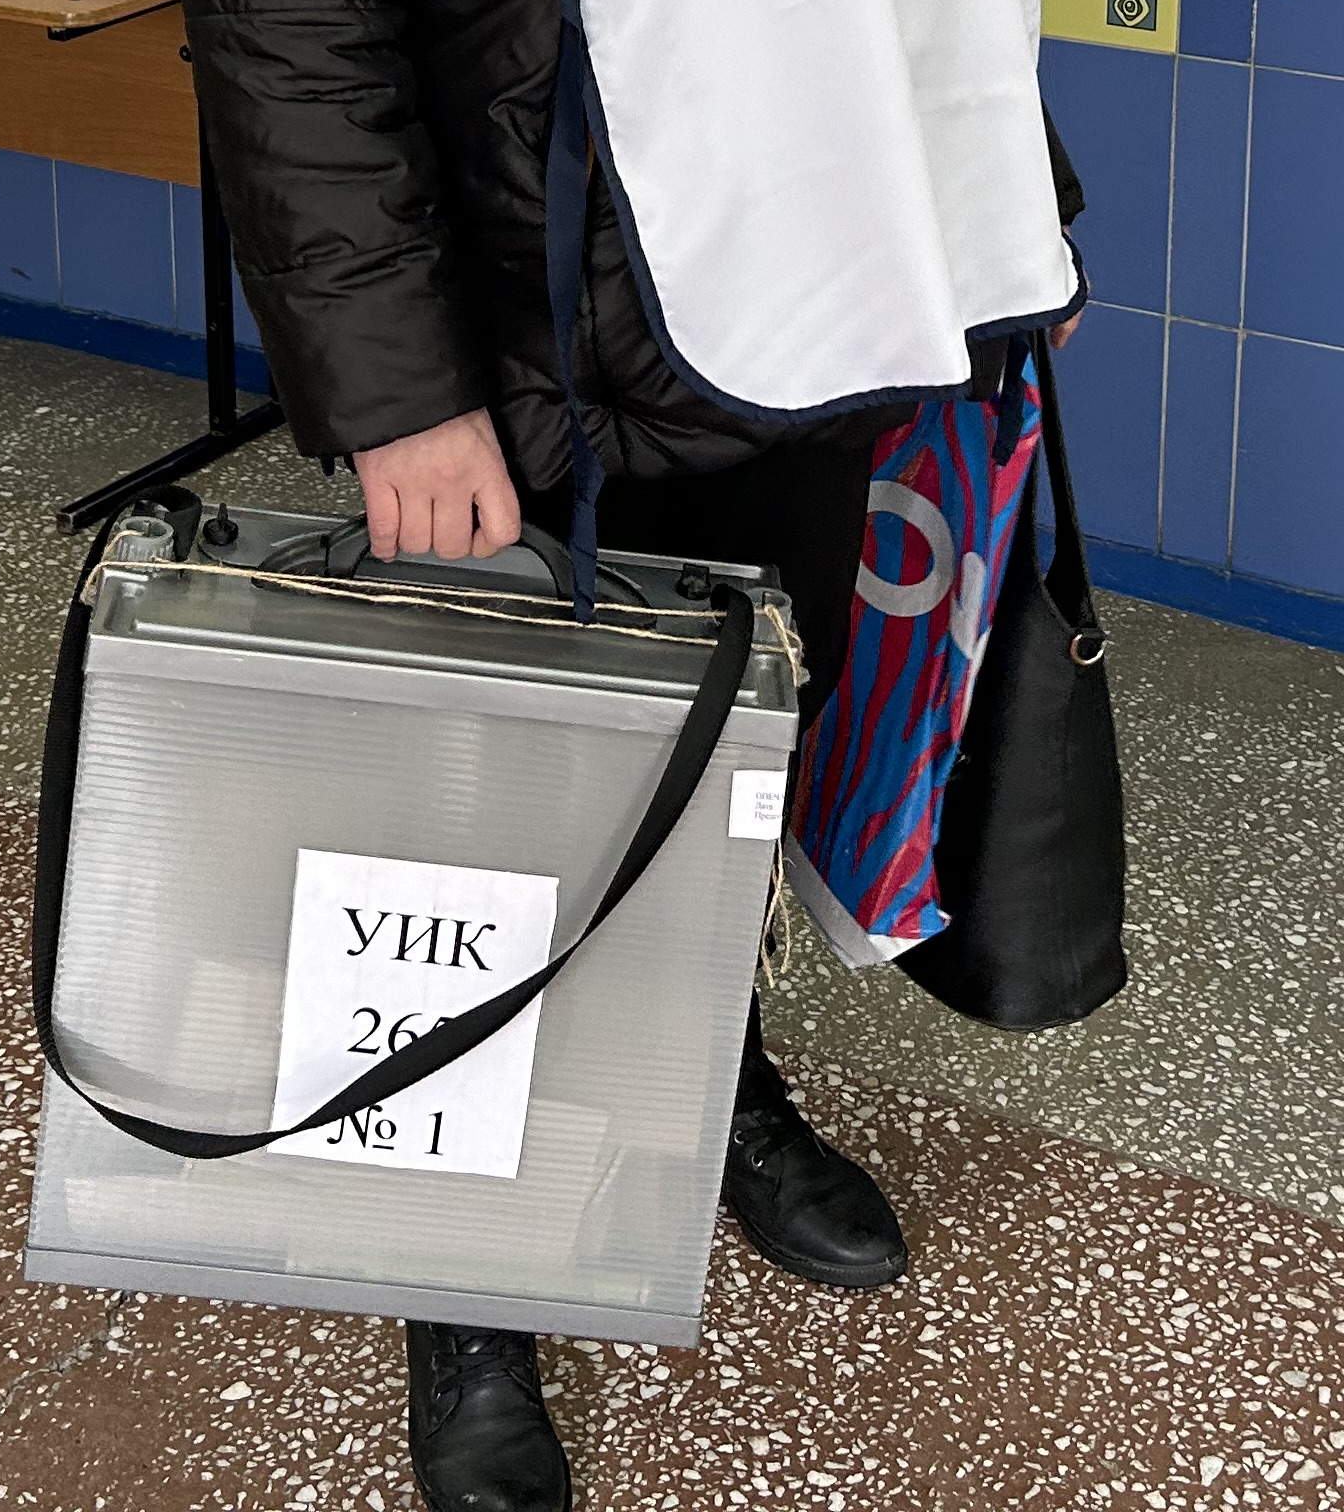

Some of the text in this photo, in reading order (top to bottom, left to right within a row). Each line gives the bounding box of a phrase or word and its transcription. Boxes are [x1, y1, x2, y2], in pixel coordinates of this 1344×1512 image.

[342, 907, 496, 971] УИК
[347, 1007, 456, 1056] 26
[327, 1105, 444, 1156] № 1
